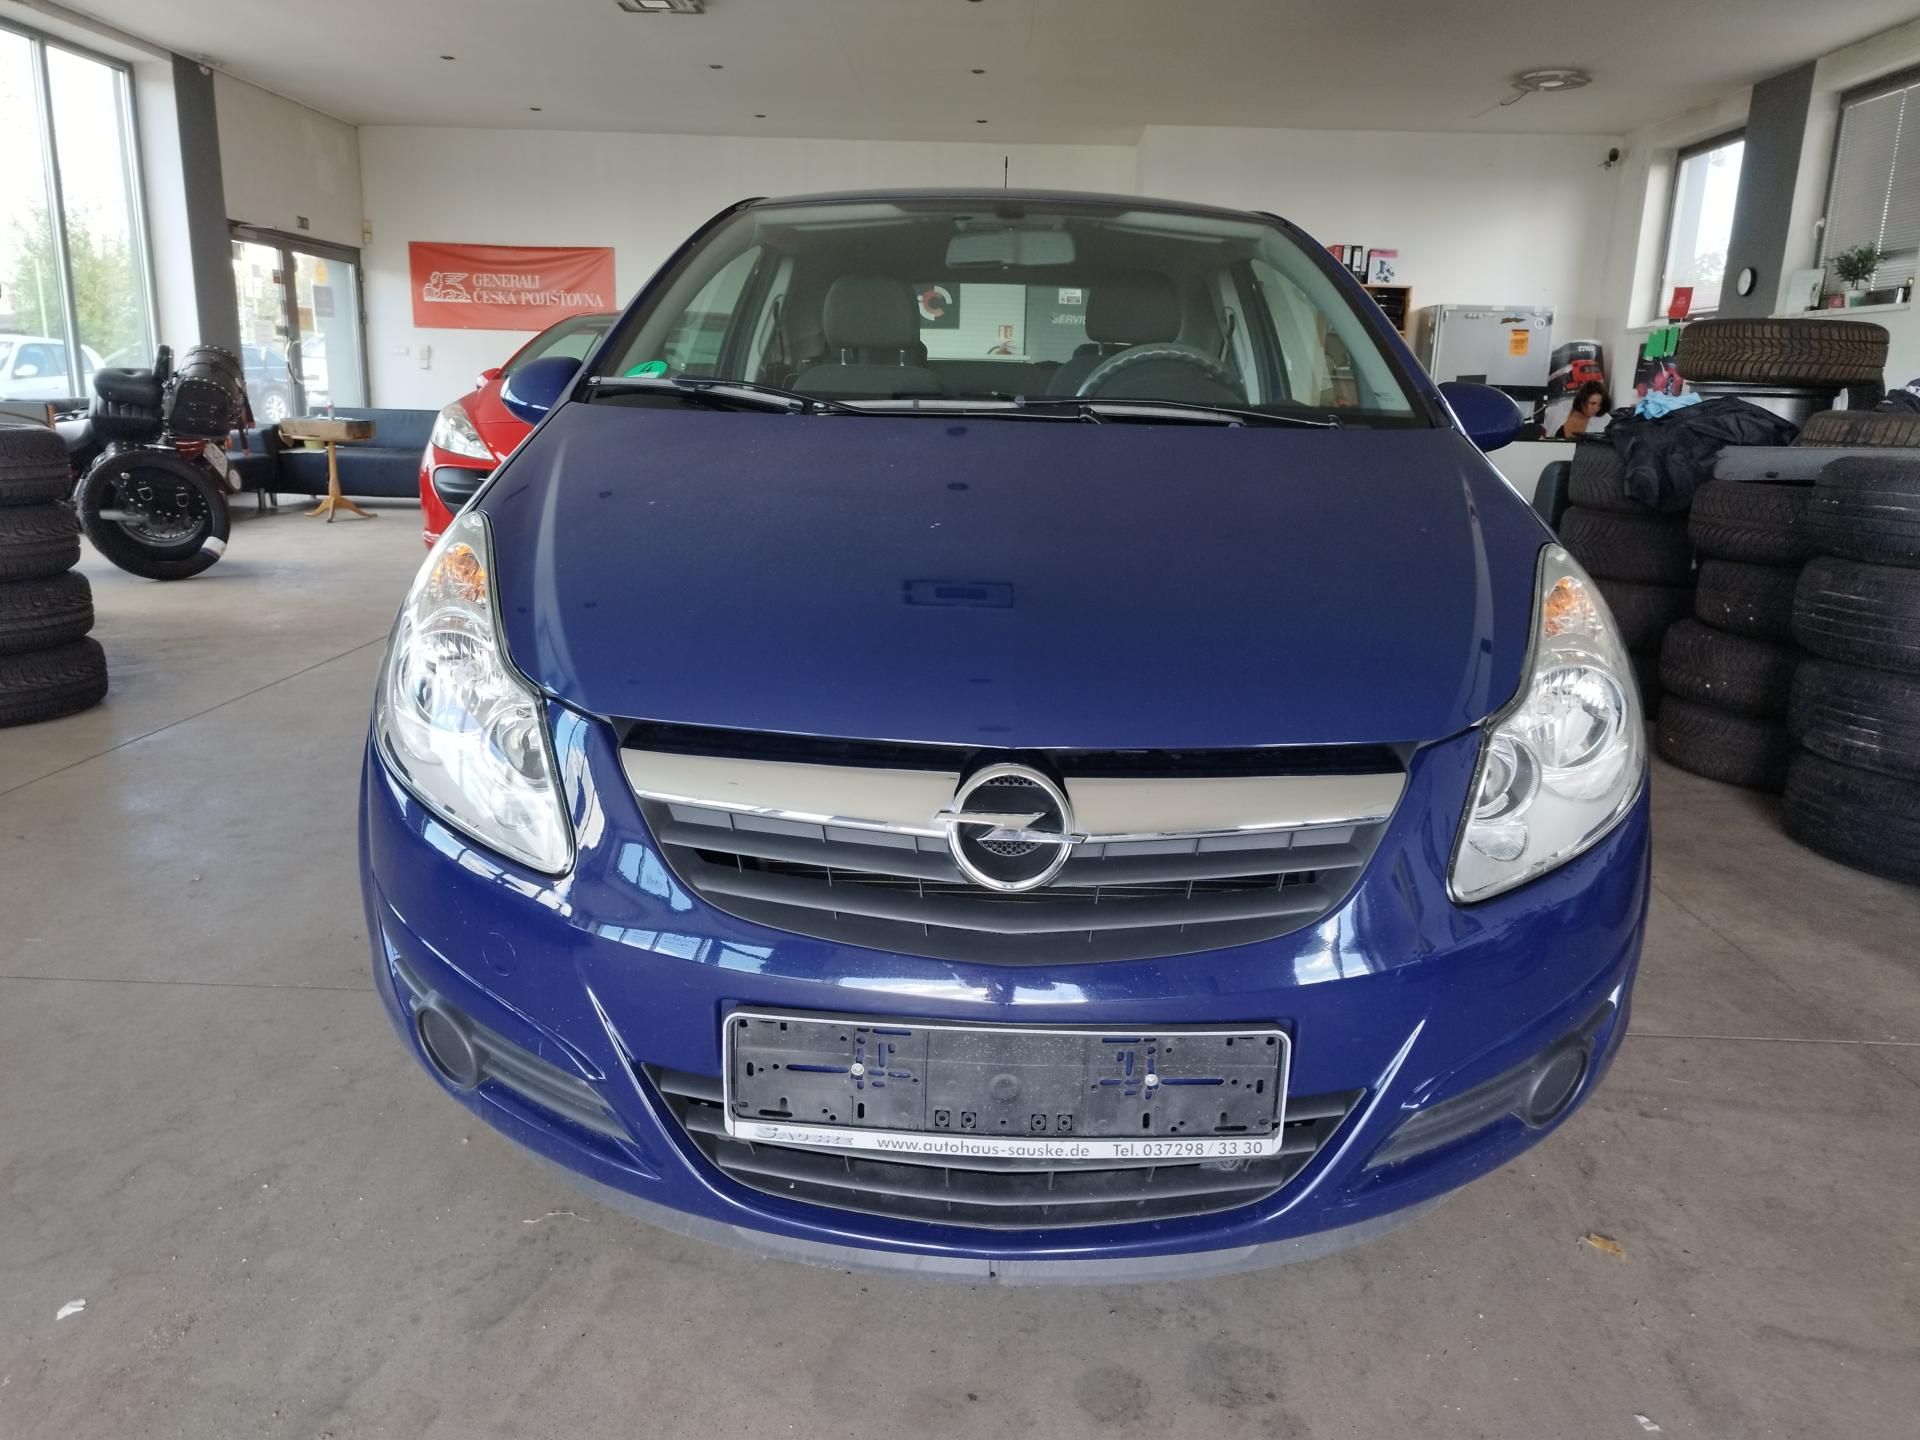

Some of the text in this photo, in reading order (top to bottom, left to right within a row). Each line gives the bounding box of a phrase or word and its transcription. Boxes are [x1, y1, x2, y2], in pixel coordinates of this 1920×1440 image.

[472, 273, 540, 289] GENERALI
[473, 288, 605, 308] ČESKÁ POJIŠŤOVNA
[876, 1138, 1090, 1158] www.autohaus-sauske.de
[1112, 1143, 1139, 1157] Tel.
[1243, 1141, 1263, 1154] 30
